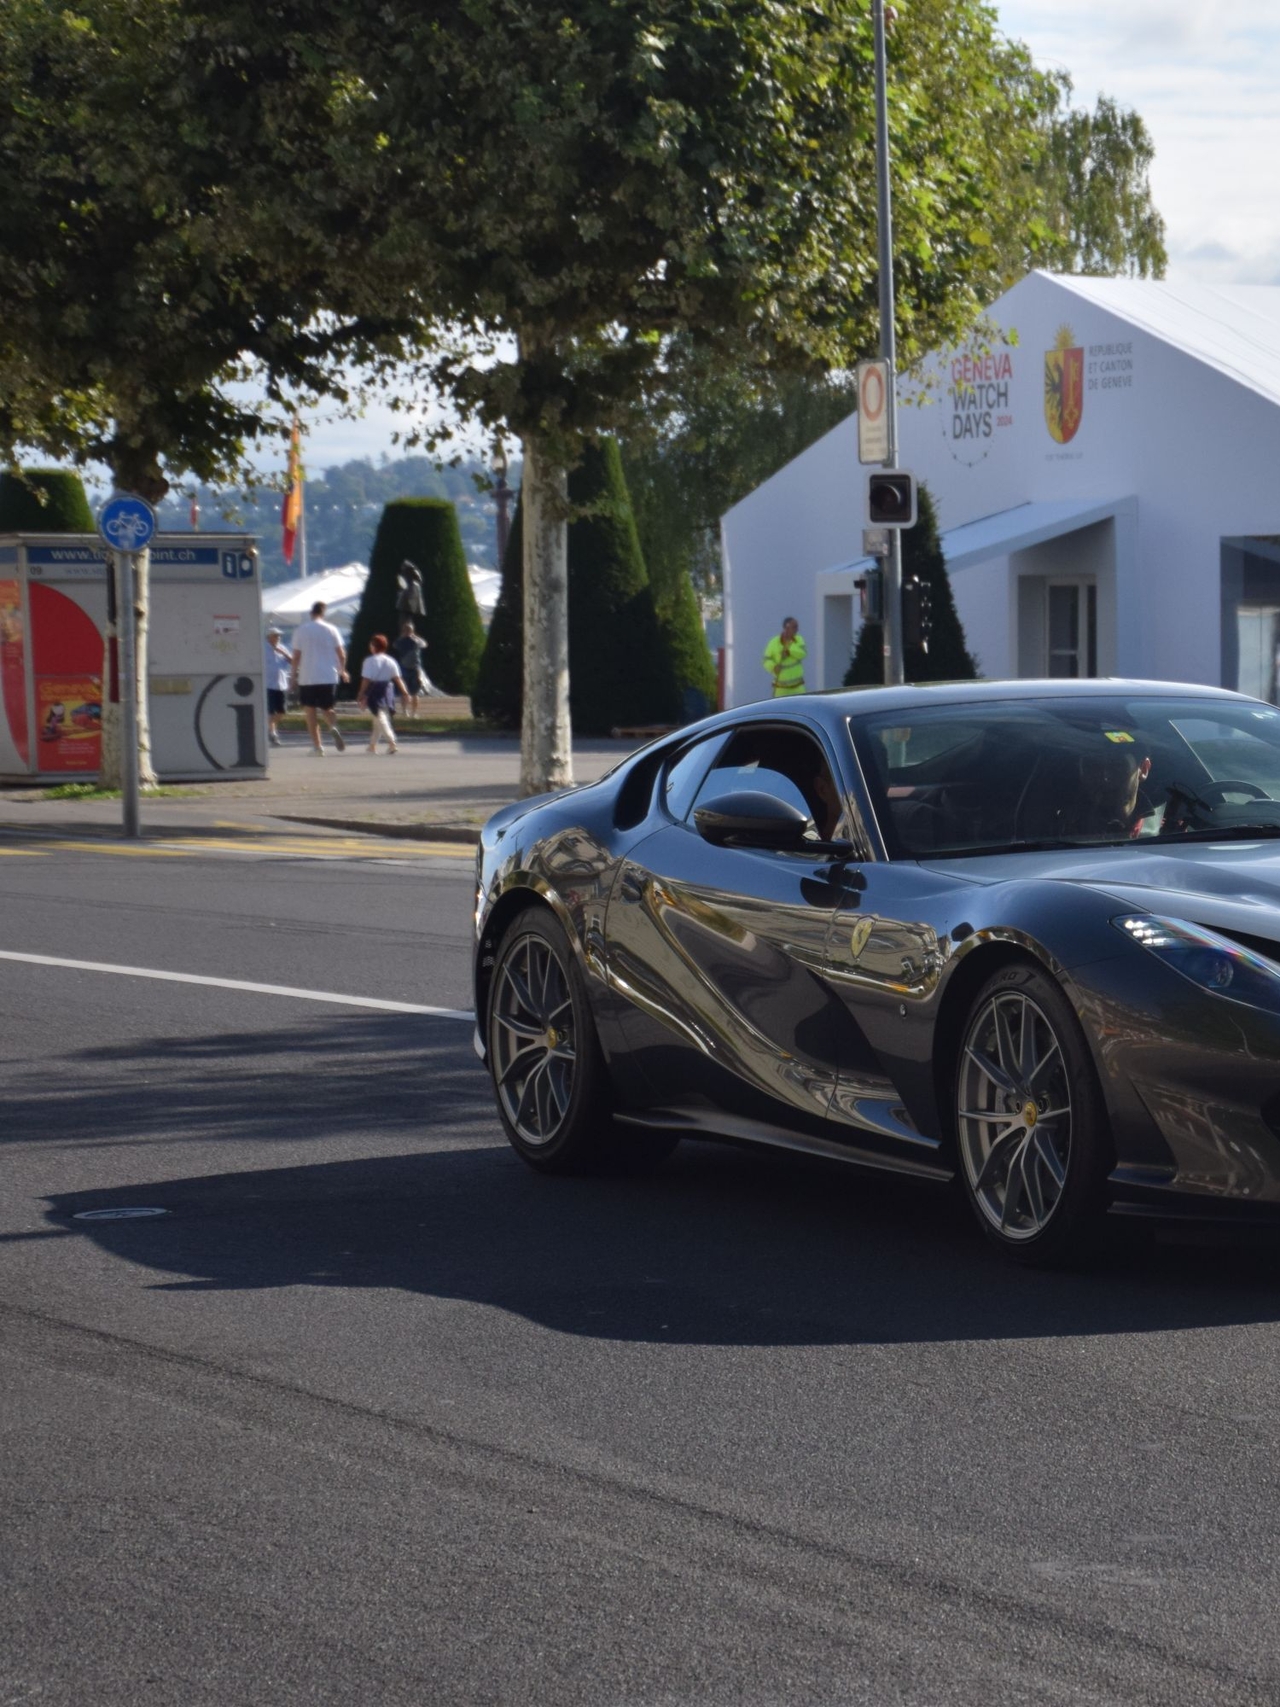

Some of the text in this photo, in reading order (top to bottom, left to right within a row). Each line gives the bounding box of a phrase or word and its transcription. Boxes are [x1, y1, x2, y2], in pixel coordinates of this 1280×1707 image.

[951, 353, 1012, 384] GENEVA
[1088, 359, 1133, 374] ET CANTON
[952, 382, 1009, 411] WATCH
[1088, 378, 1098, 390] DE
[952, 412, 993, 439] DAYS
